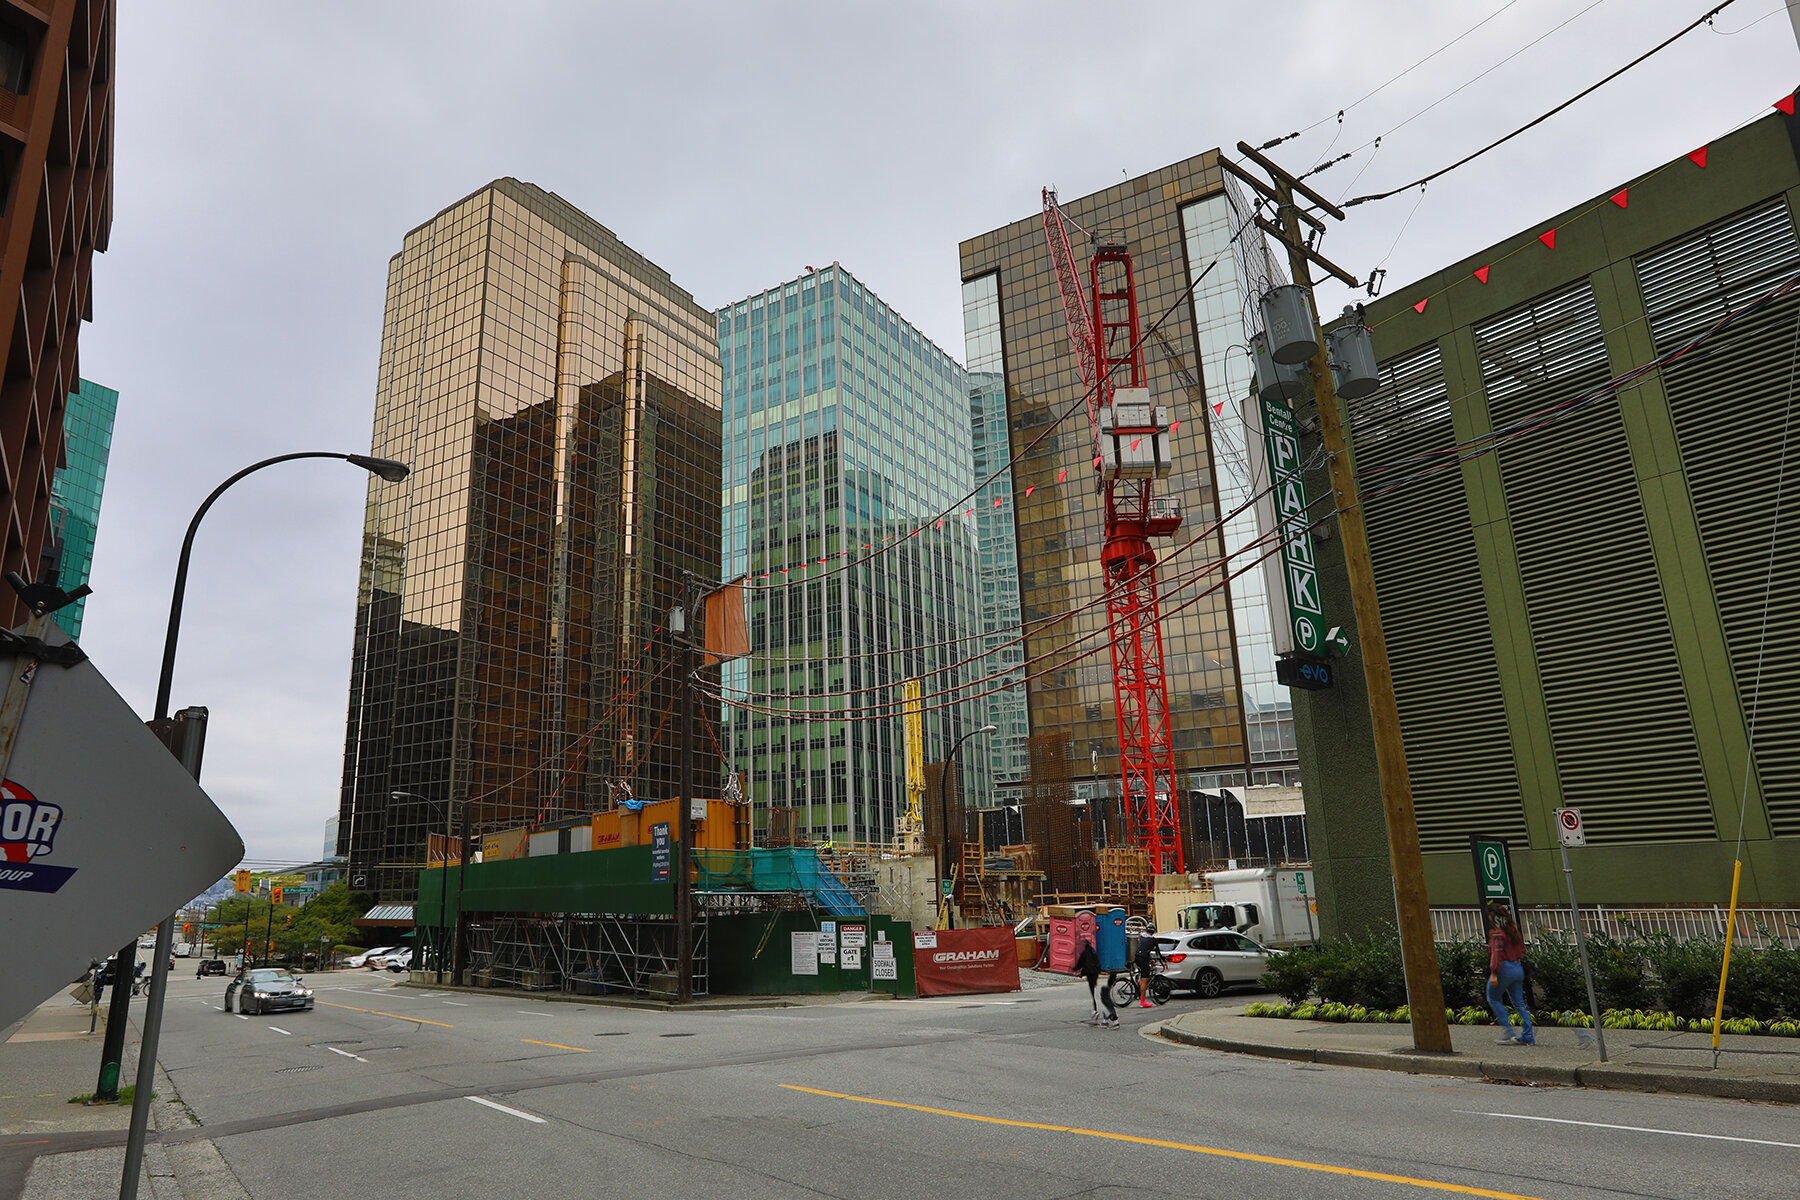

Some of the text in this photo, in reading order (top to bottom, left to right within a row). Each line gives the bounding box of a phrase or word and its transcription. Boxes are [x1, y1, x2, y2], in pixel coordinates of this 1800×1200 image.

[1266, 401, 1292, 421] Bentall
[1269, 414, 1293, 432] Centre
[1275, 434, 1316, 609] PARK
[1301, 622, 1312, 645] P
[654, 825, 668, 836] Thank
[656, 838, 665, 848] you
[1487, 853, 1497, 875] P
[935, 950, 999, 961] GRAHAM
[875, 968, 894, 977] CLOSED
